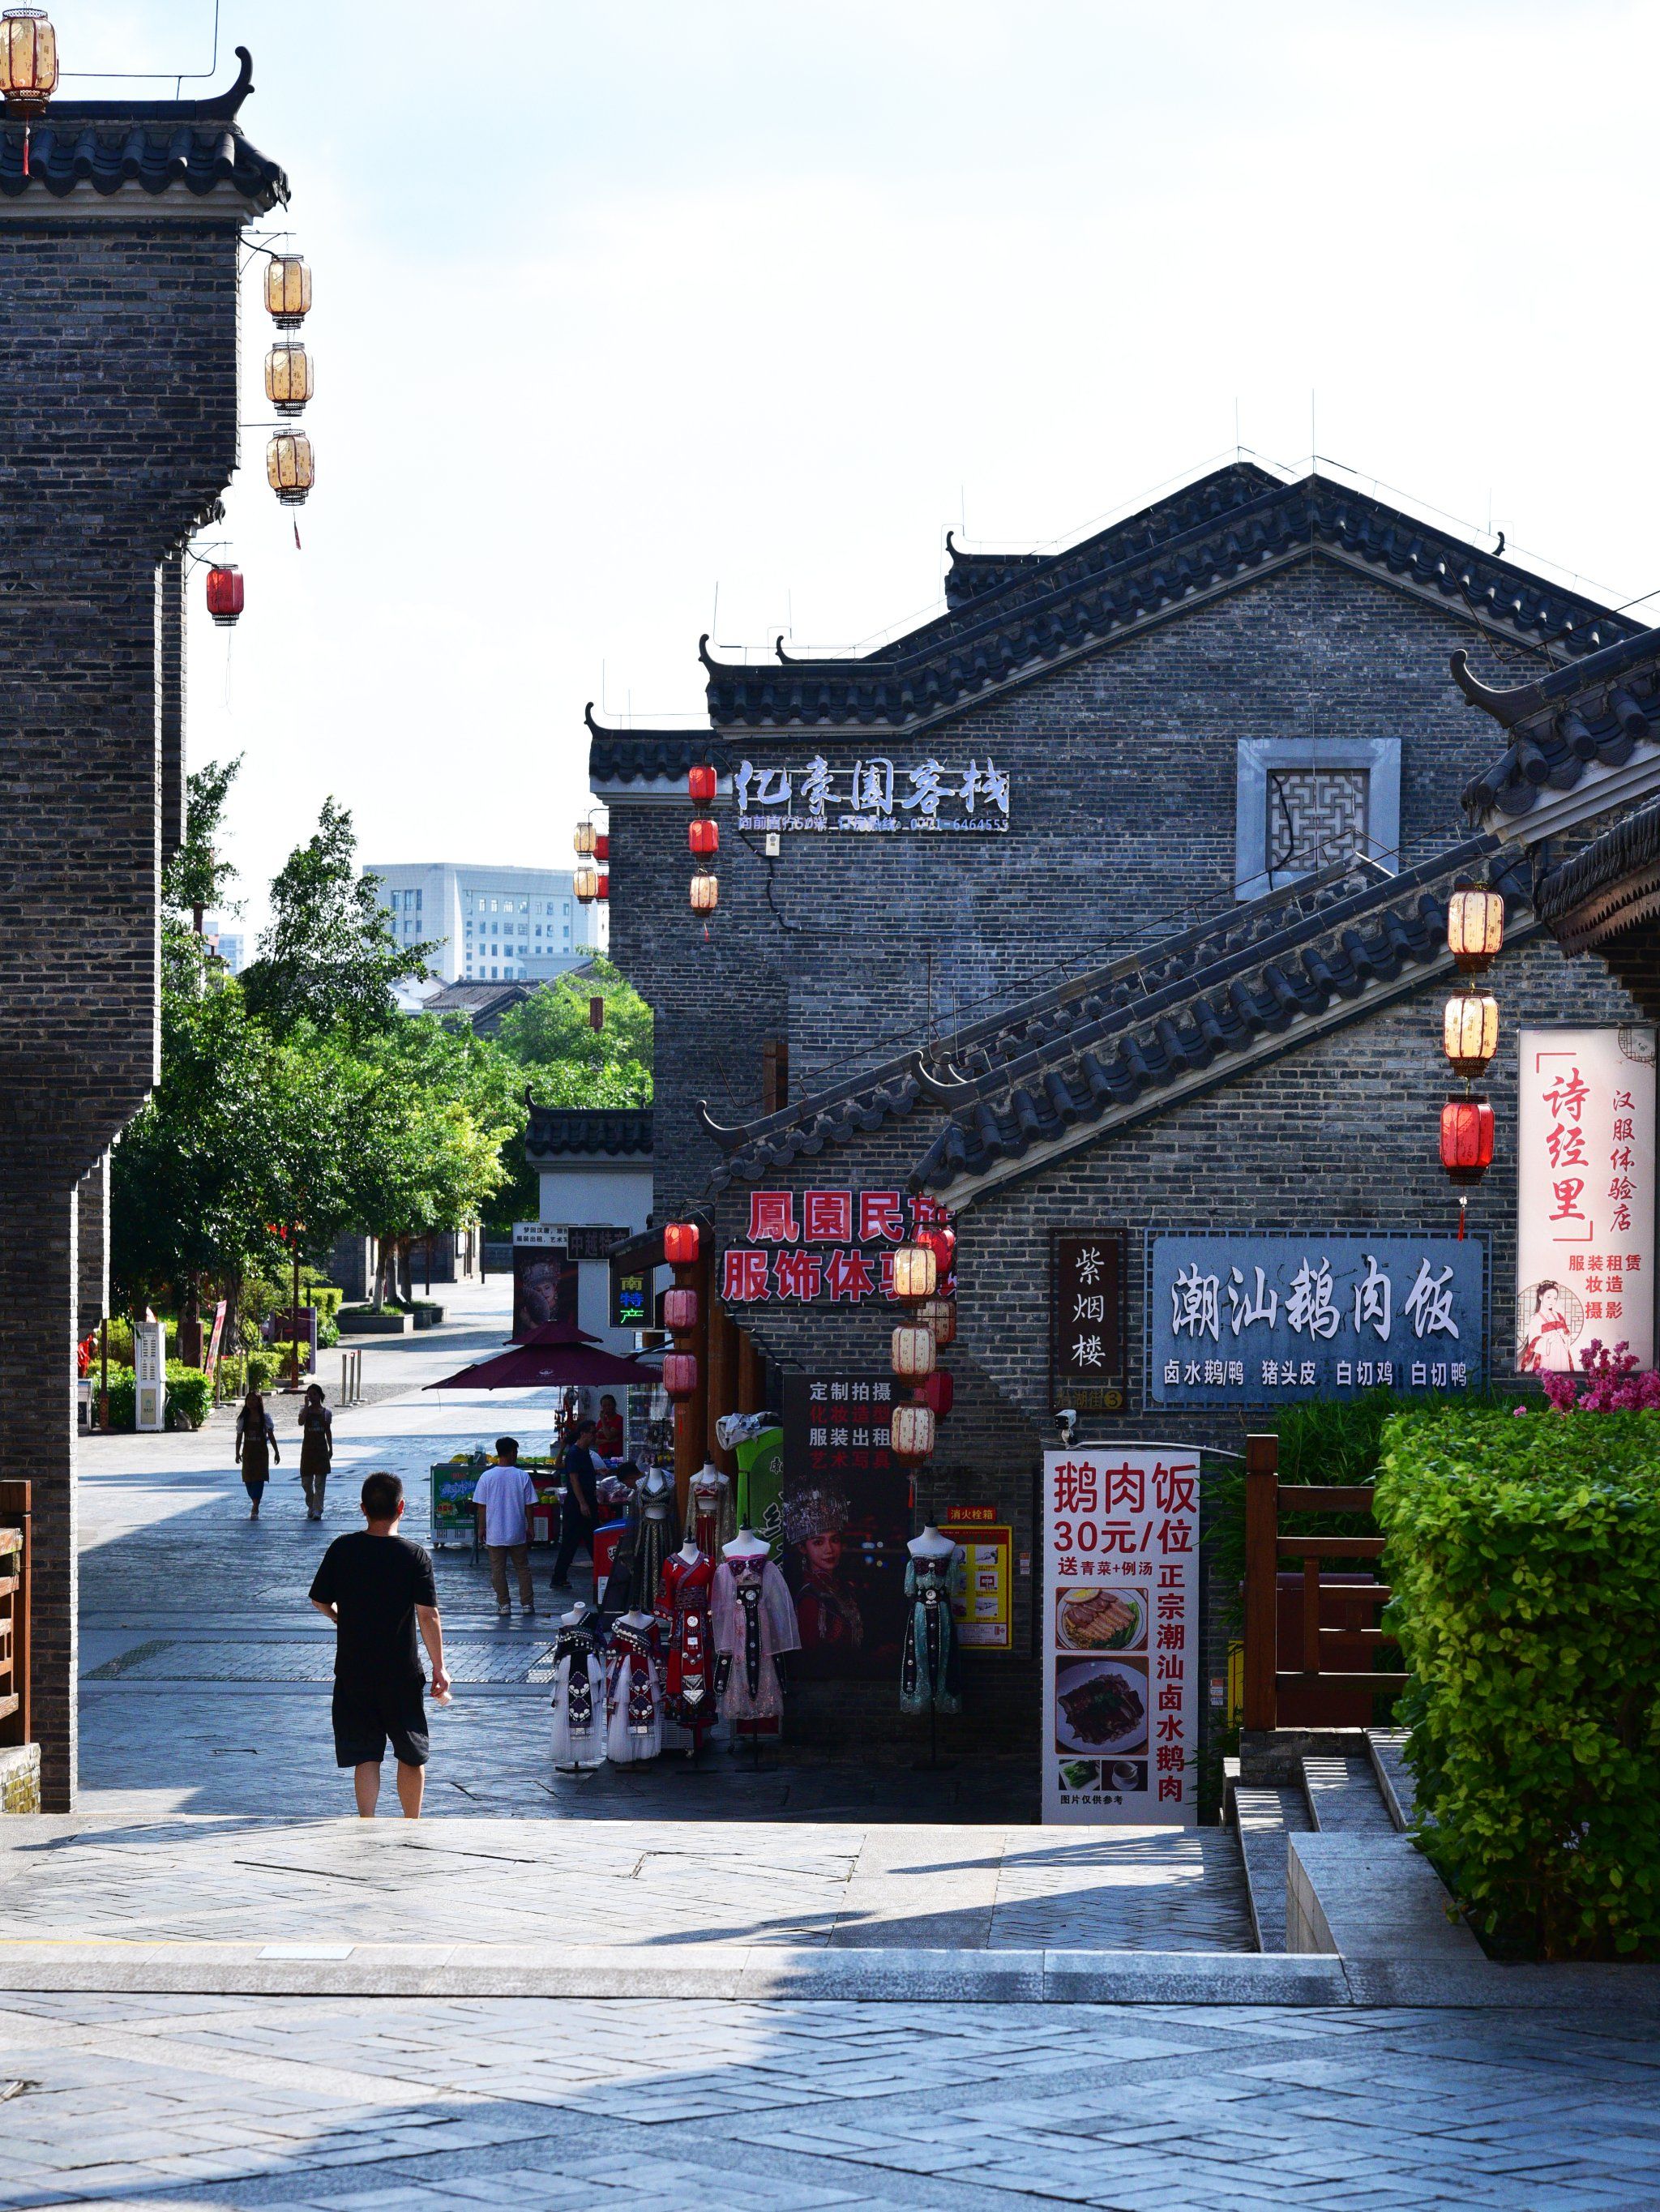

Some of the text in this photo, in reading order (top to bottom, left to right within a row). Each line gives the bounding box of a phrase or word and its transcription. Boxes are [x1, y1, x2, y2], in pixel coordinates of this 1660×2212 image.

[909, 817, 1009, 832] 0771-6464555
[1542, 1067, 1590, 1222] 诗经里
[1608, 1090, 1637, 1232] 汉服体验店
[1568, 1254, 1641, 1272] 服装租赁
[1585, 1275, 1624, 1294] 妆造
[1071, 1247, 1106, 1367] 紫烟楼
[1171, 1255, 1460, 1342] 潮汕鹅肉饭
[1585, 1301, 1623, 1320] 摄影
[1164, 1359, 1467, 1388] 卤水鹅/鸭 猪头皮 白切鸡 白切鸭
[810, 1382, 891, 1401] 定制拍摄
[811, 1405, 891, 1424] 化妆造型
[810, 1428, 892, 1447] 服装出租
[811, 1449, 890, 1470] 艺术写真
[1054, 1461, 1197, 1514] 鹅肉饭
[951, 1509, 993, 1520] 消火栓箱
[1054, 1518, 1193, 1554] 30元/位
[1058, 1556, 1153, 1577] 送青菜+例汤
[1156, 1564, 1186, 1803] 正宗潮汕卤水鹅肉
[1060, 1795, 1123, 1805] 图片仅供参考
